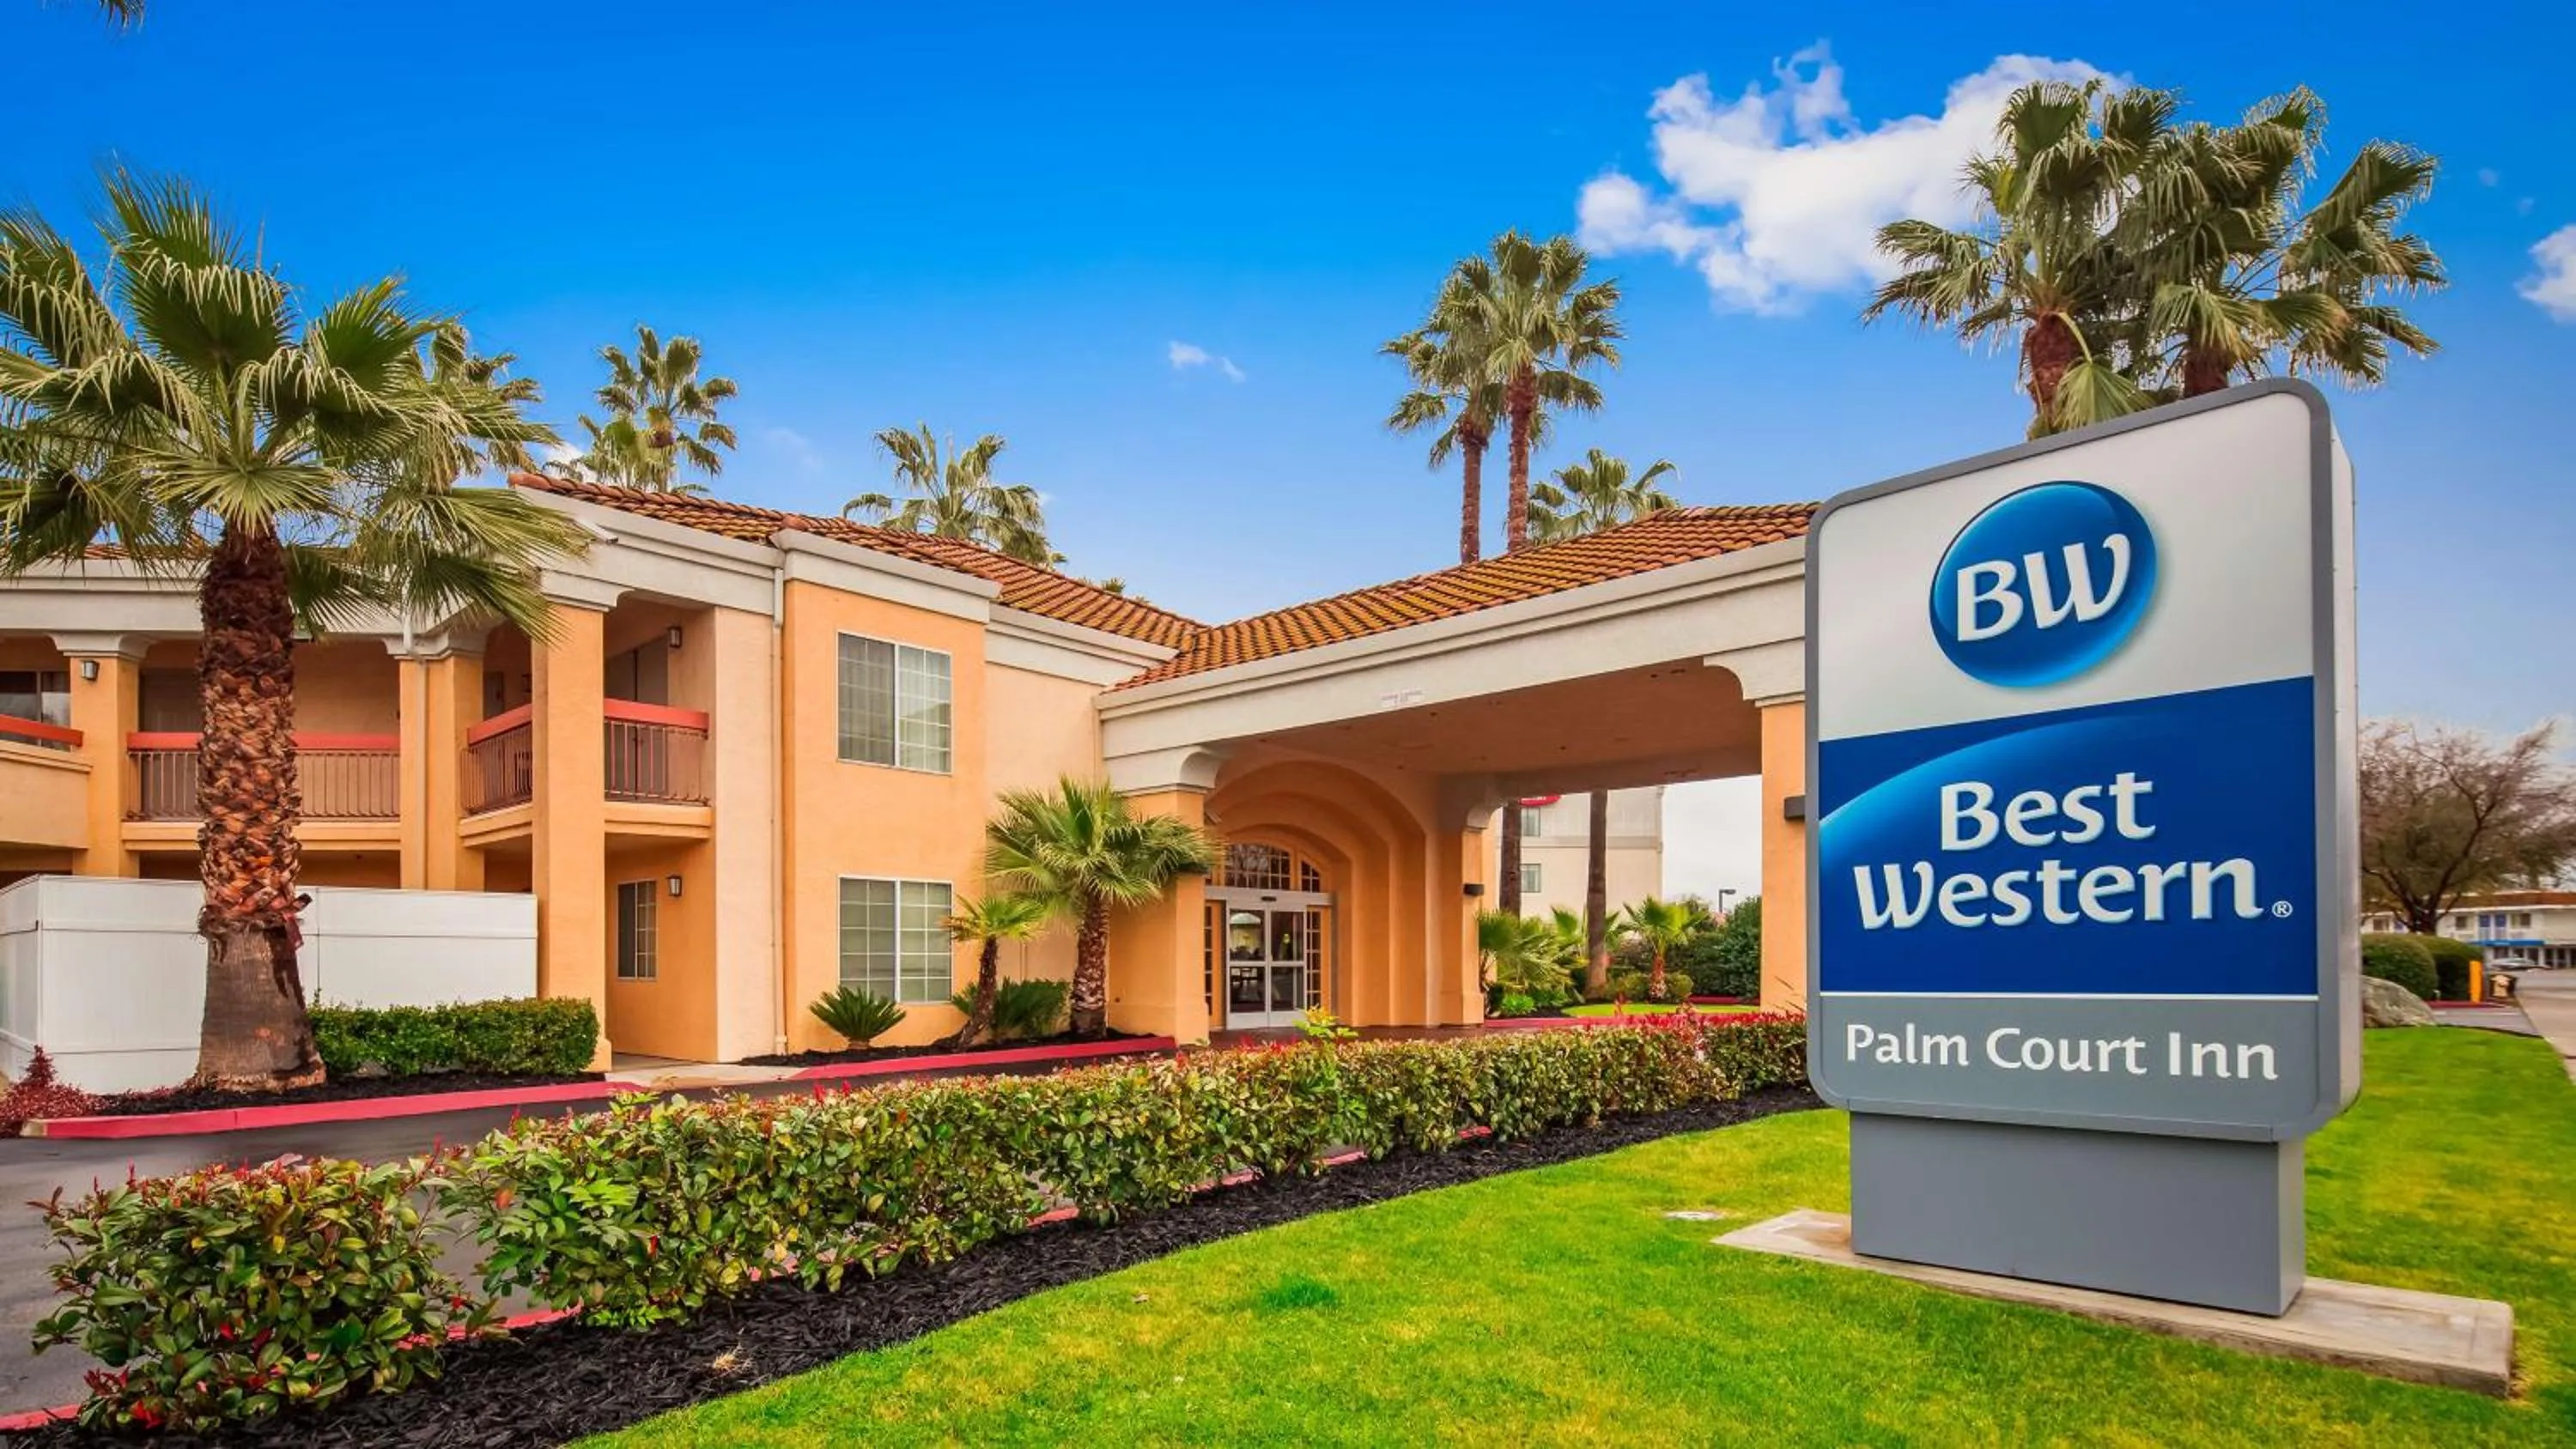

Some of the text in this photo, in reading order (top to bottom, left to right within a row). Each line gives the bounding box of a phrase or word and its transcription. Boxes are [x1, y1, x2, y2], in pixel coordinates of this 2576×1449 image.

[1956, 532, 2131, 642] BW
[1940, 771, 2157, 852] Best
[1846, 1022, 2280, 1081] Palm Court Inn
